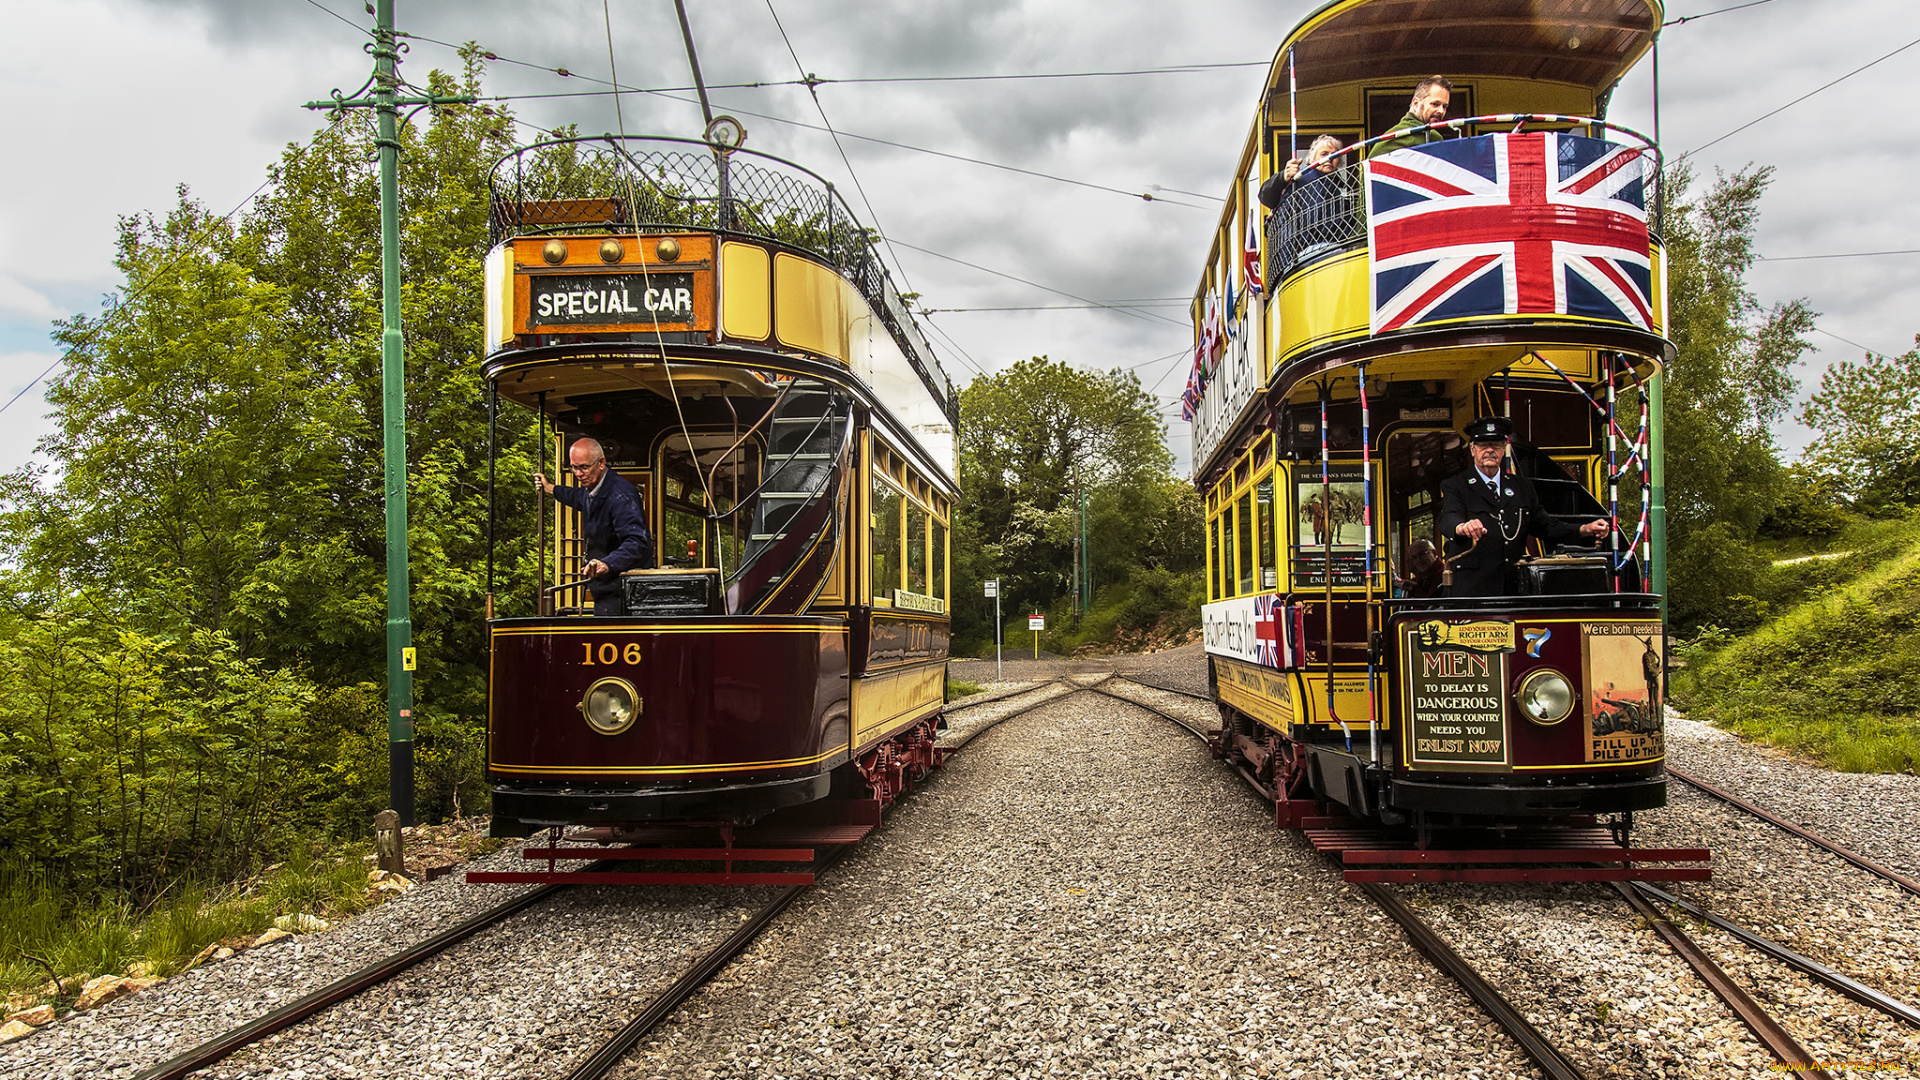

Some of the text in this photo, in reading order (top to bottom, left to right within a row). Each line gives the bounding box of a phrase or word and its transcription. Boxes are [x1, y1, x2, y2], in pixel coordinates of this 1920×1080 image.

[537, 287, 692, 317] SPECIAL CAR
[1340, 575, 1362, 583] NOW!
[1612, 623, 1631, 635] both
[1633, 623, 1653, 635] needed
[1522, 627, 1552, 658] 7
[582, 642, 642, 666] 106
[1422, 651, 1490, 678] MEN
[1424, 684, 1489, 692] TO DELAY IS
[1416, 697, 1498, 709] DANGEROUS
[1416, 713, 1500, 722] WHEN YOUR COUNTRY
[1429, 726, 1486, 735] NEEDS YOU
[1417, 738, 1502, 753] ENLIST NOW
[1592, 739, 1626, 749] FILL
[1631, 737, 1646, 747] UP
[1593, 749, 1620, 760] PILE
[1625, 748, 1640, 758] UP
[1642, 746, 1657, 756] THE
